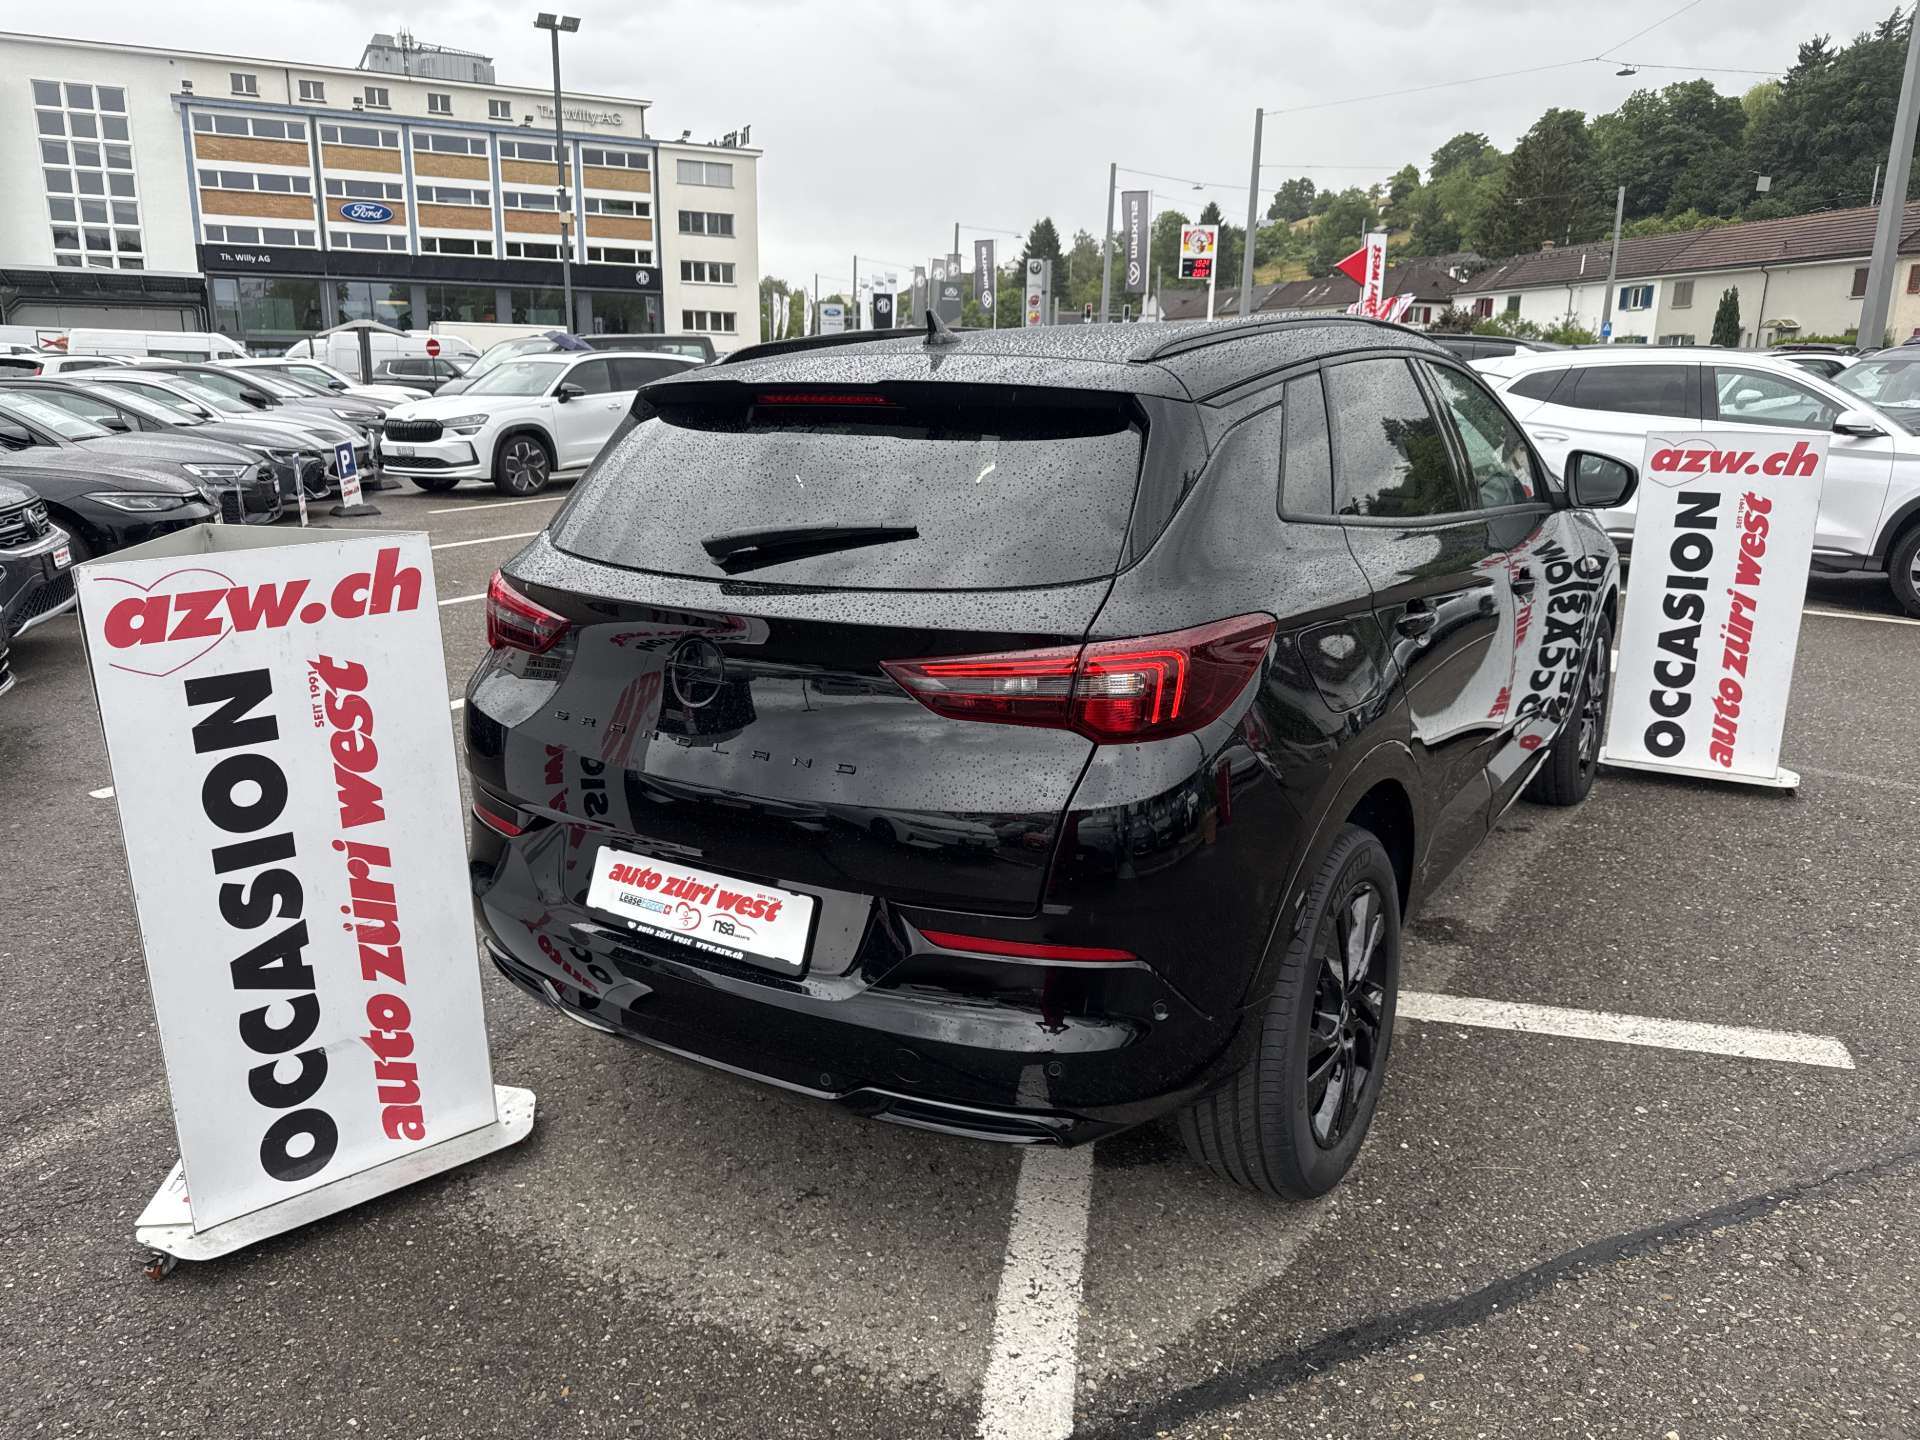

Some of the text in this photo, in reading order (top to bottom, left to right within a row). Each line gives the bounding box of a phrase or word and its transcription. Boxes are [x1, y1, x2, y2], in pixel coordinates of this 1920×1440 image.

[601, 113, 622, 126] AG
[351, 204, 383, 219] Ford
[220, 253, 271, 264] Th. Willy AG
[340, 450, 351, 474] P
[1650, 441, 1819, 477] azw.ch
[103, 547, 423, 650] azw.ch
[1644, 491, 1721, 758] OCCASION
[1709, 491, 1773, 768] auto züri west
[307, 670, 325, 728] SEIT 1991
[554, 710, 857, 775] GRANDLAND
[307, 654, 426, 1141] auto züri west
[608, 862, 785, 922] auto züri west
[184, 668, 339, 1182] OCCASION
[637, 924, 655, 935] auto
[673, 934, 693, 946] west
[712, 919, 735, 936] nsa
